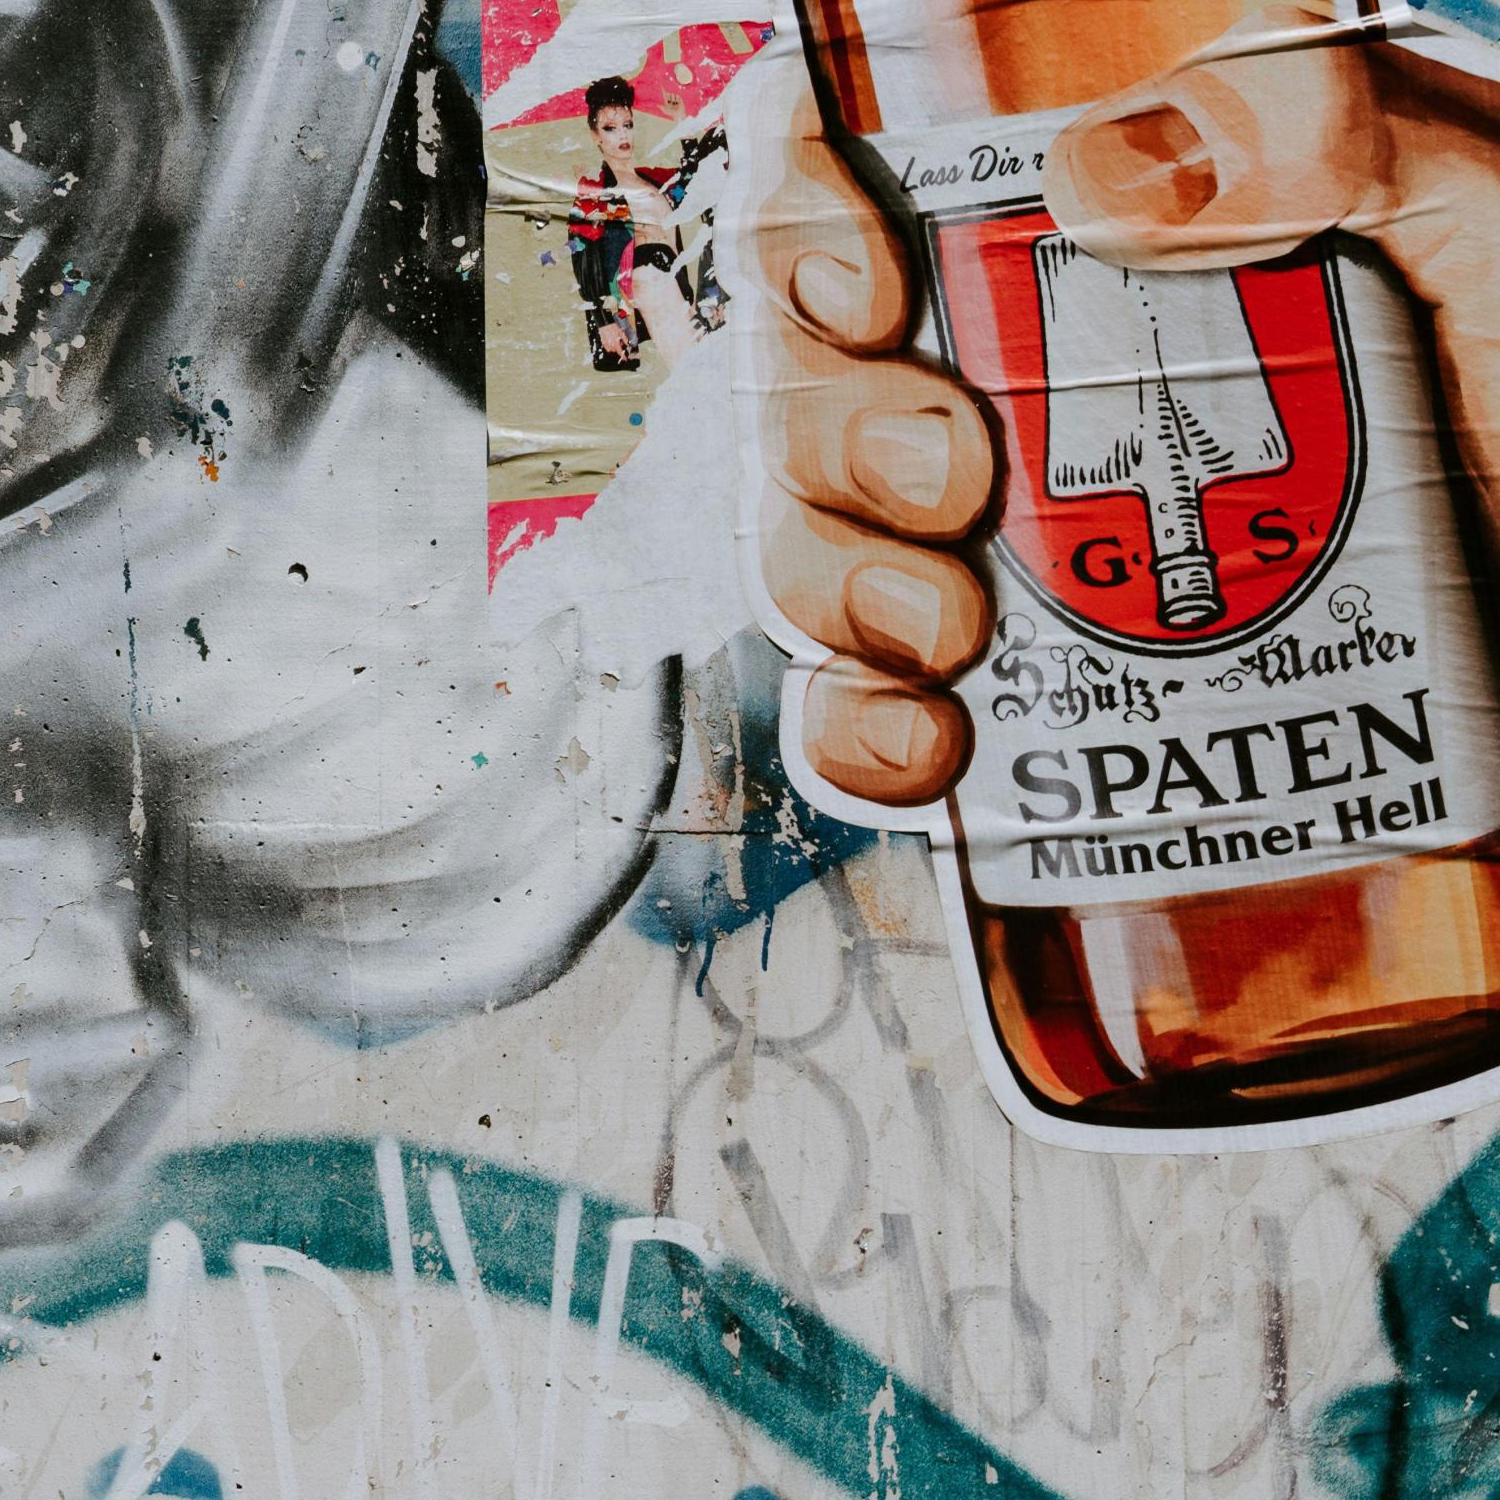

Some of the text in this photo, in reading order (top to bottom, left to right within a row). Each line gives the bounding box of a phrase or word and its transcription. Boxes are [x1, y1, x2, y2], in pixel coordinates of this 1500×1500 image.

[900, 156, 964, 194] Lass
[969, 144, 1024, 182] Dir
[1012, 687, 1435, 825] SPATEN
[1030, 776, 1449, 880] Münchner Hell
